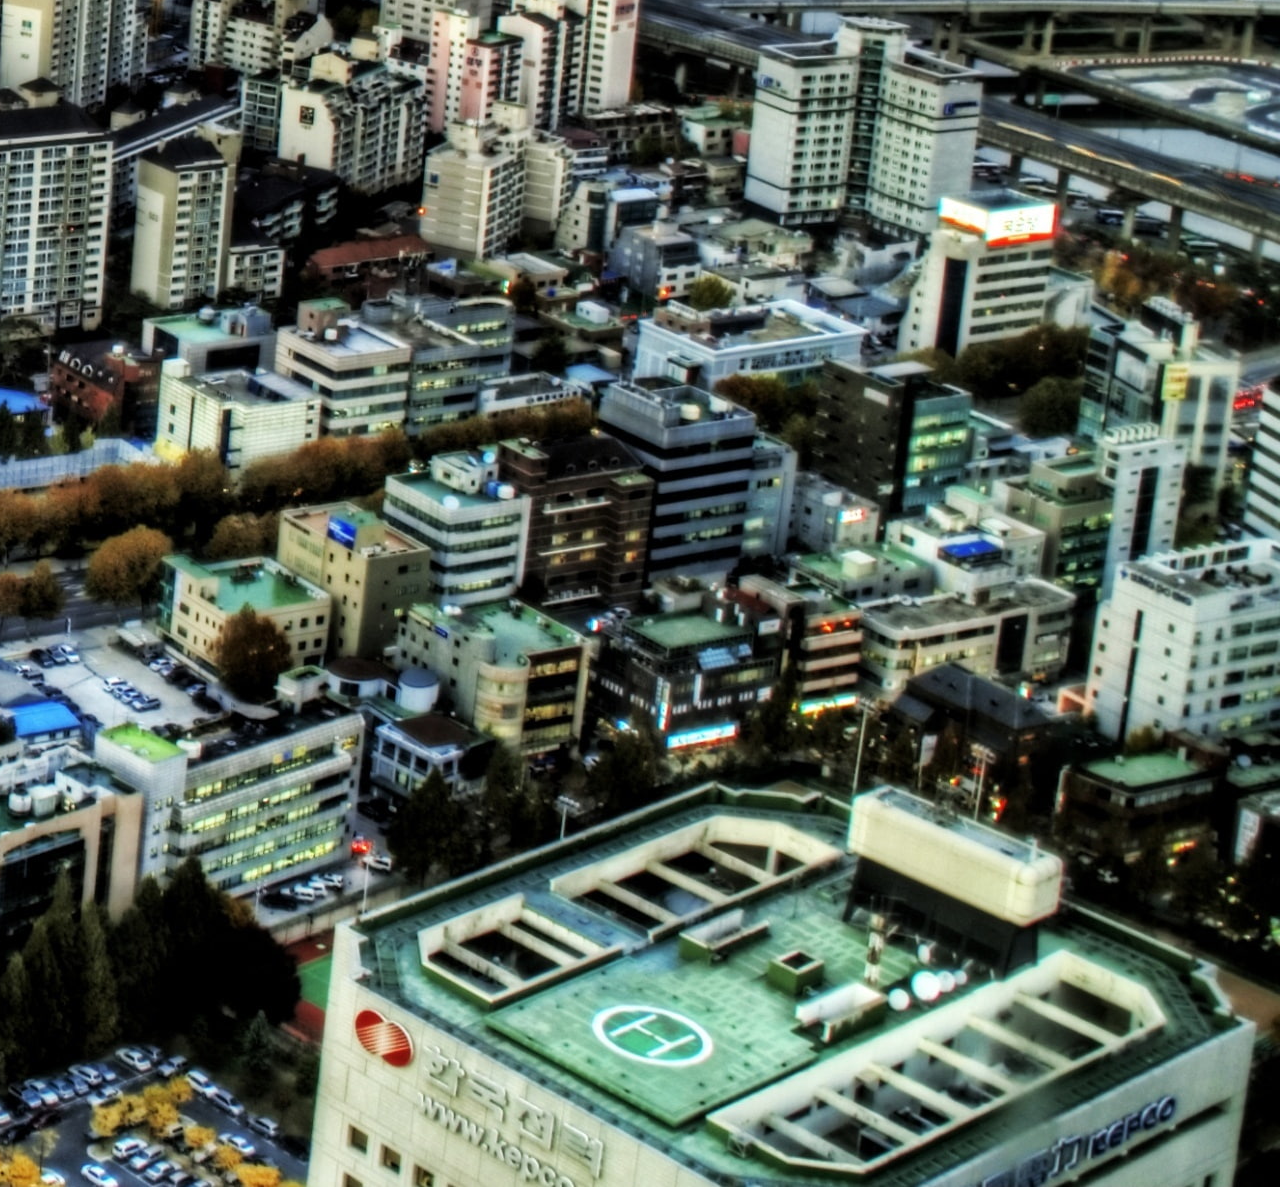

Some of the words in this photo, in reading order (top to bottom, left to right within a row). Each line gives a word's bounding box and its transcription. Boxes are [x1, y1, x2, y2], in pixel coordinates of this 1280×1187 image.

[609, 1014, 696, 1057] H
[422, 1045, 604, 1180] 한국전력
[1087, 1095, 1177, 1160] KEPCO
